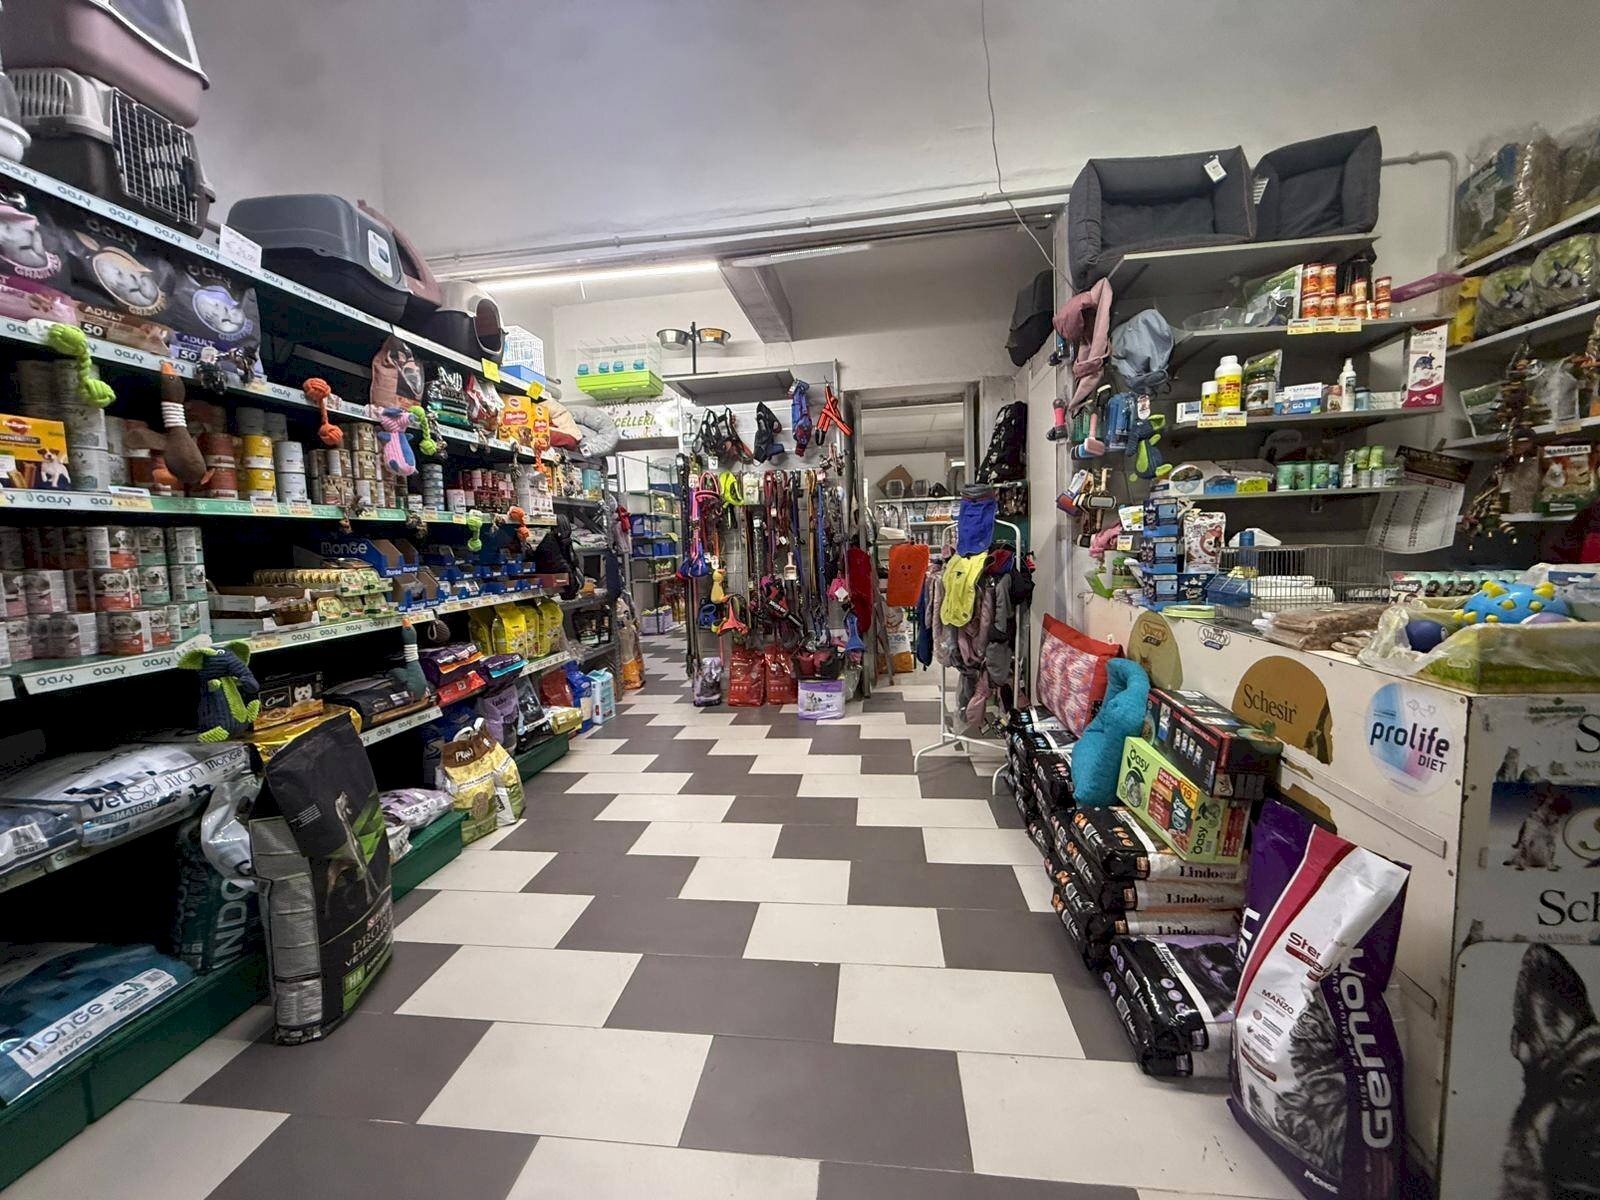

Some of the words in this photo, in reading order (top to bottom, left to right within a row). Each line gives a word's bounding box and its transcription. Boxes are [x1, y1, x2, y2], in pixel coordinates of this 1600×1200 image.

[84, 305, 125, 321] ADULT
[83, 323, 104, 336] 50
[90, 497, 113, 506] oas
[36, 674, 74, 687] oasy
[93, 664, 126, 677] oasy
[142, 656, 171, 668] oasy
[1243, 683, 1297, 724] Schesir
[1370, 721, 1450, 758] prolife
[1128, 744, 1150, 773] Oasy
[1418, 754, 1447, 773] DIET
[1262, 989, 1295, 1015] MANZO
